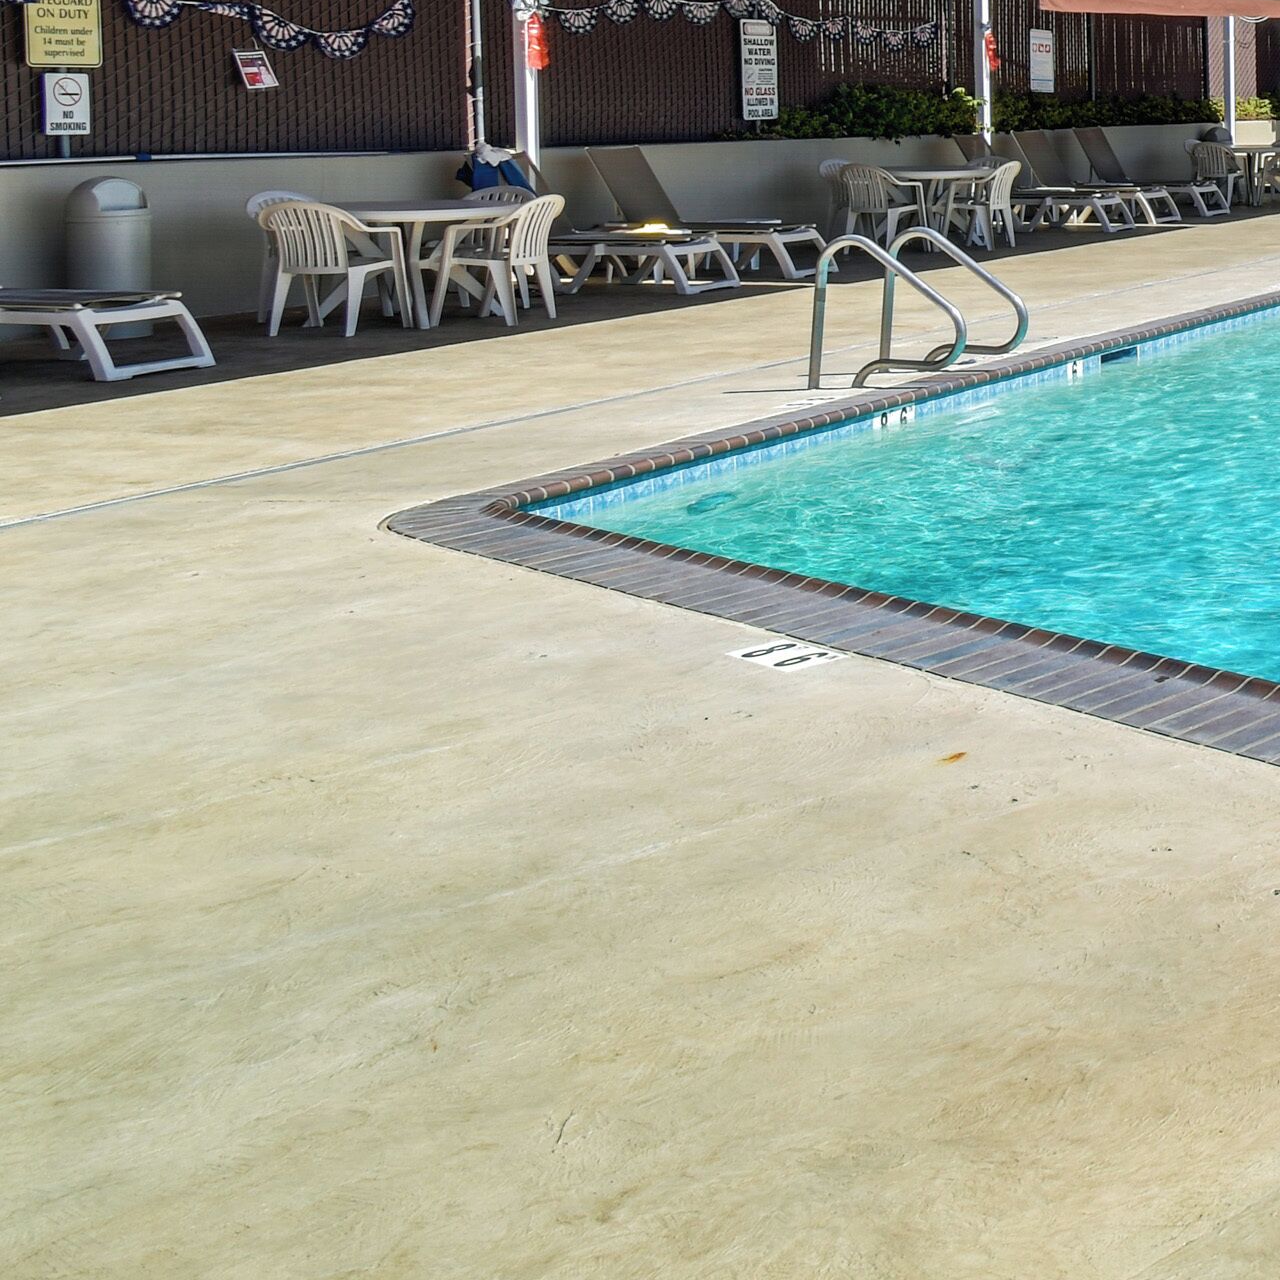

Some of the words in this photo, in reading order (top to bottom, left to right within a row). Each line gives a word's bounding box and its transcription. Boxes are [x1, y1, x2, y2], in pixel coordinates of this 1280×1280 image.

[36, 7, 55, 18] ON
[59, 8, 90, 19] DUTY
[34, 25, 68, 35] Children
[70, 26, 93, 36] under
[43, 37, 52, 45] 14
[55, 37, 74, 46] must
[76, 37, 87, 46] be
[743, 37, 775, 46] SHALLOW
[44, 48, 85, 58] supervised
[748, 48, 771, 56] WATER
[744, 57, 753, 65] NO
[755, 57, 776, 66] DIVING
[744, 87, 754, 96] NO
[756, 87, 776, 96] GLASS
[62, 110, 74, 119] NO
[50, 122, 87, 131] SMOKING
[741, 643, 797, 658] 8
[773, 652, 829, 667] 6
